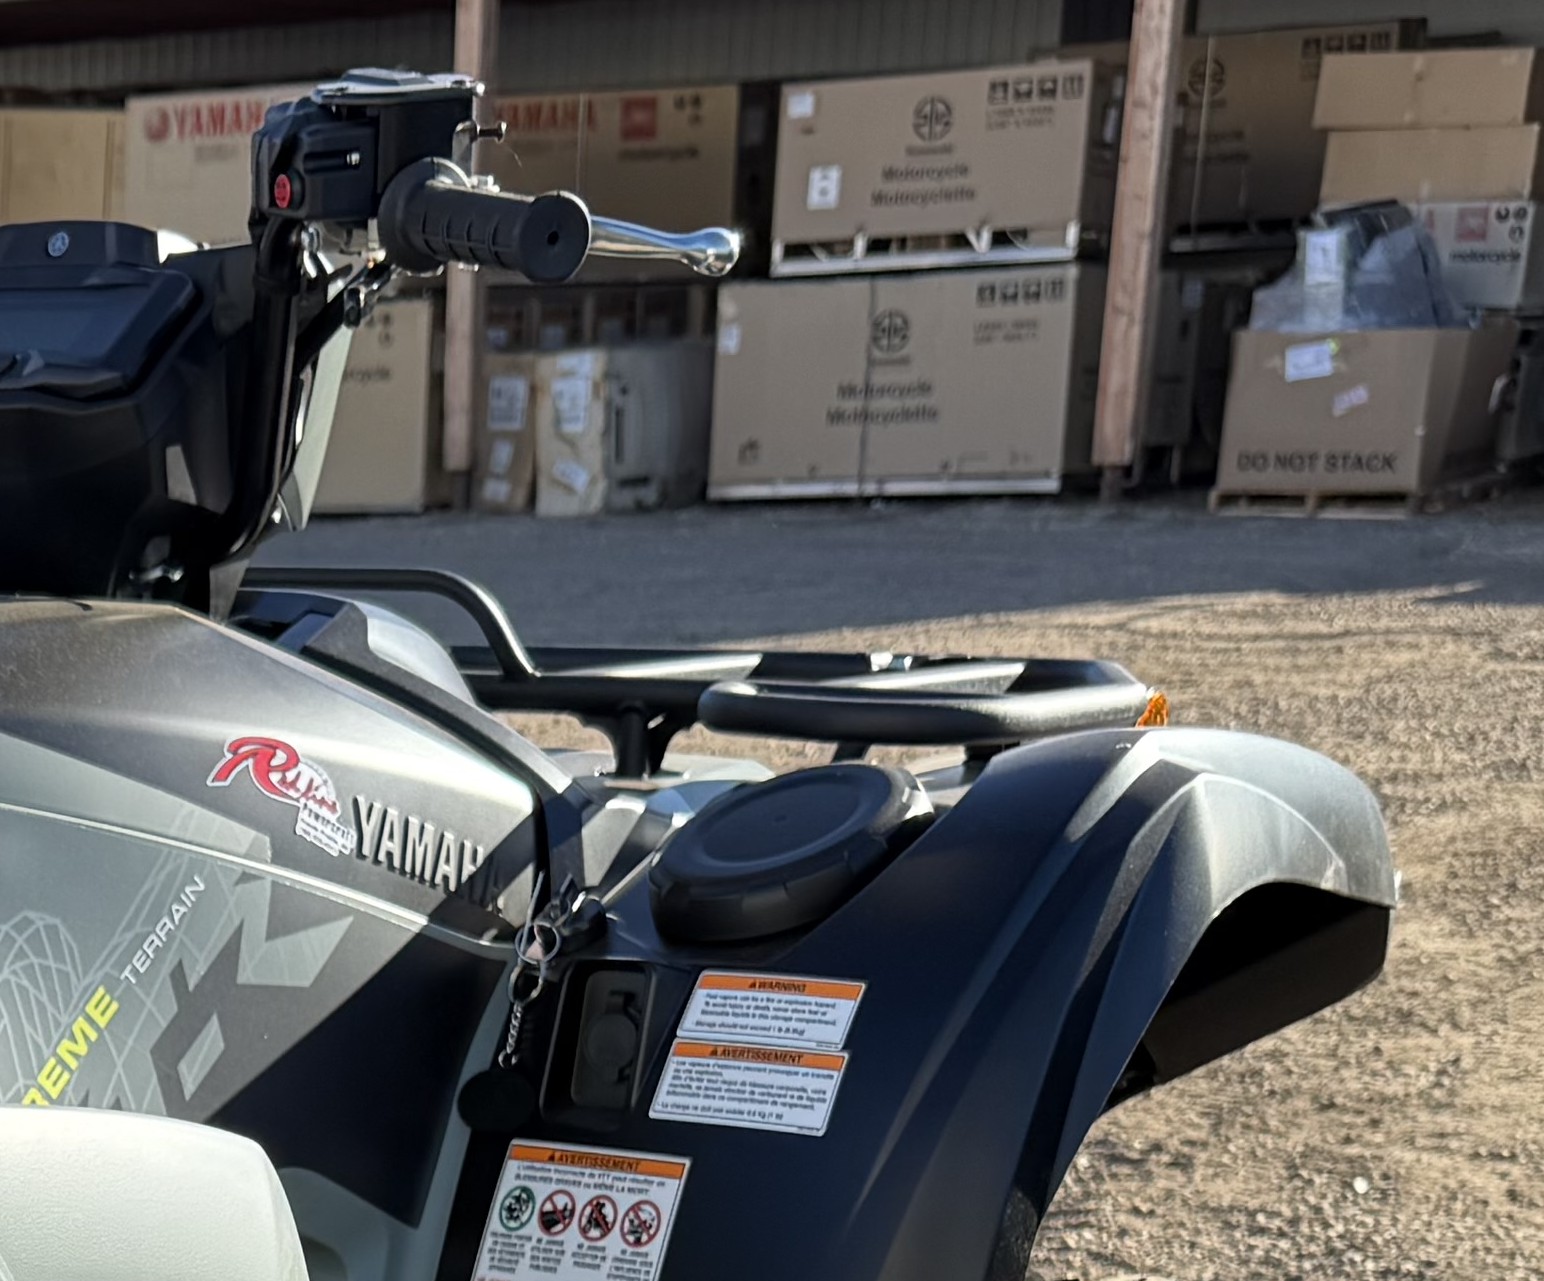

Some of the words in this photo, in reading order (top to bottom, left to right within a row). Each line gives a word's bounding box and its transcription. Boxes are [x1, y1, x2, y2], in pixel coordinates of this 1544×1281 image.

[174, 102, 265, 143] YAMAH
[1235, 450, 1267, 474] DO
[1272, 451, 1320, 474] NOT
[1323, 450, 1398, 475] STACK
[353, 795, 484, 893] YAMAH
[22, 985, 120, 1106] REME
[120, 874, 207, 985] TERRAIN
[755, 978, 808, 994] WARNING
[718, 1046, 804, 1065] AVERTISSEMENT
[556, 1151, 642, 1173] AVERTISSEMENT
